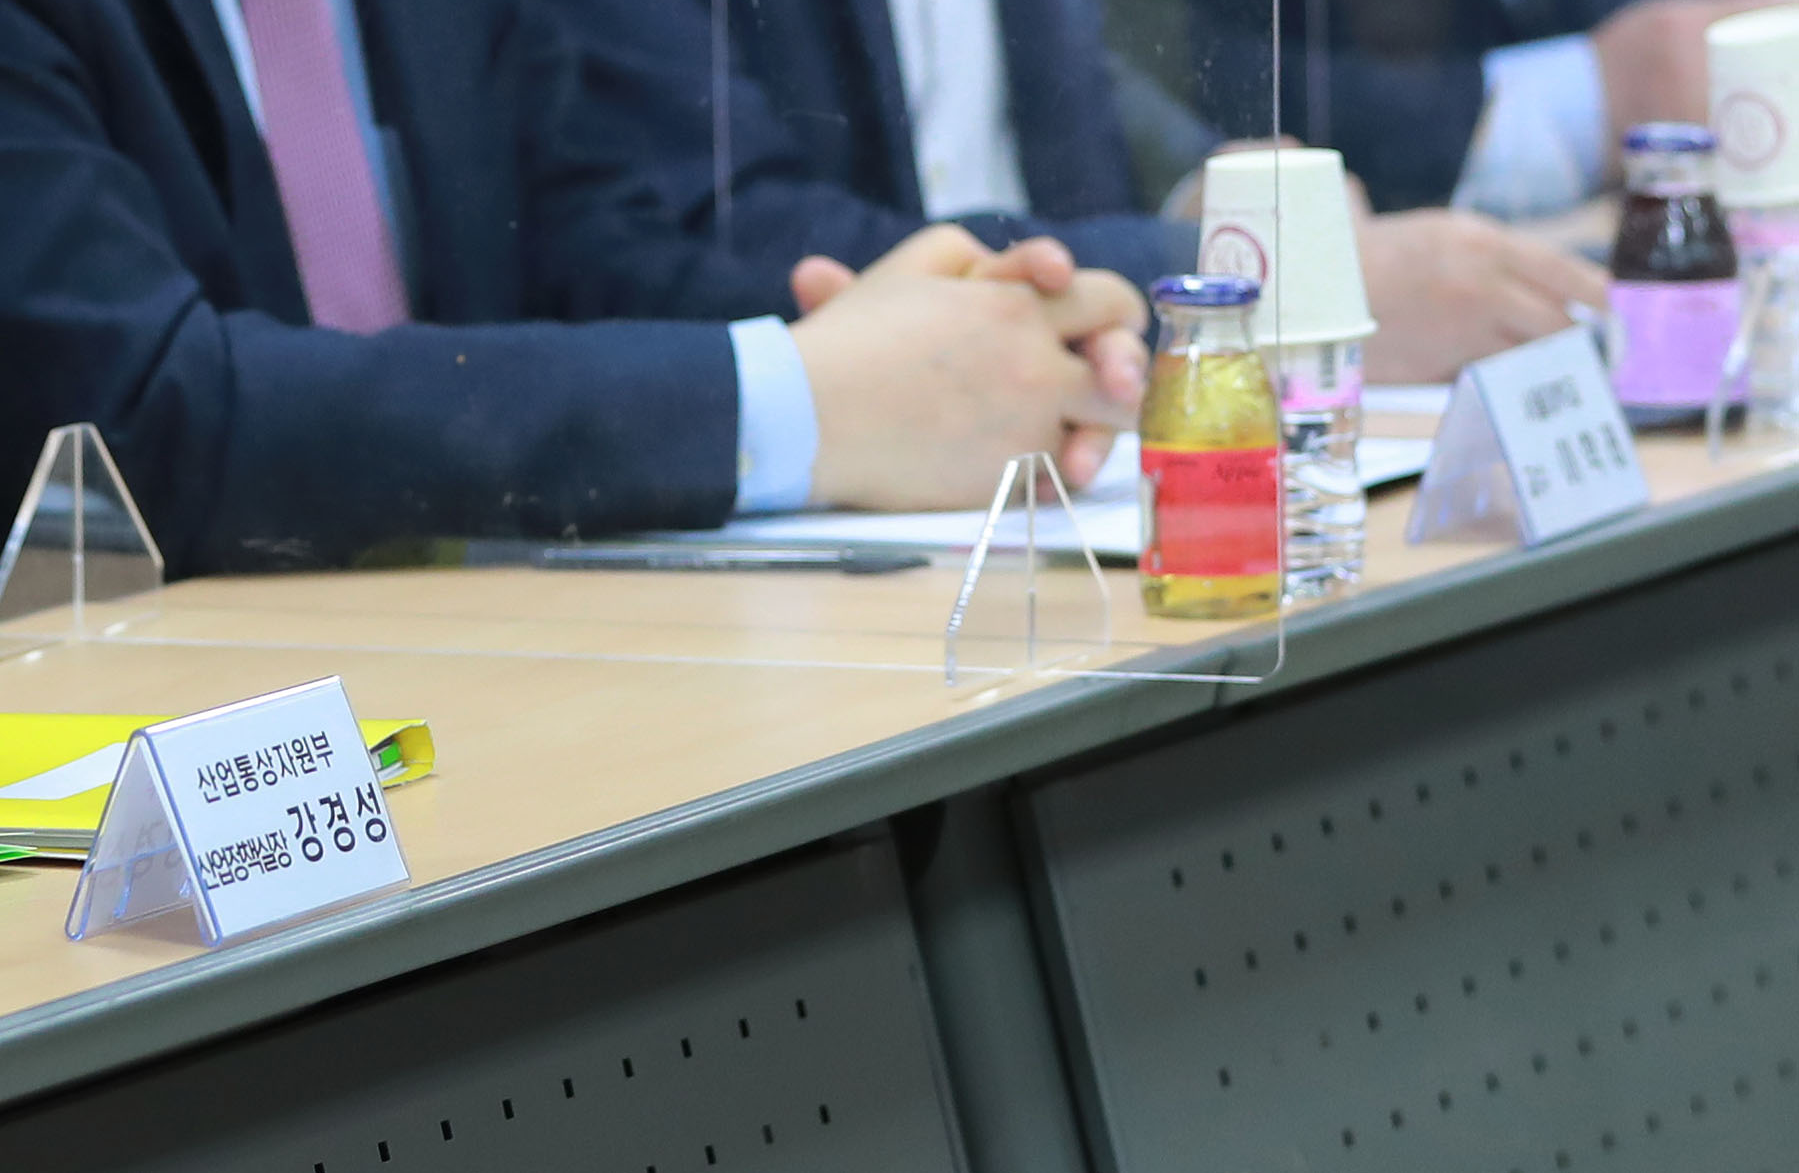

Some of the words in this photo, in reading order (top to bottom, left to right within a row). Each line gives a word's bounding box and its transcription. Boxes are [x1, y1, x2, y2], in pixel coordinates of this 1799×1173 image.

[197, 730, 334, 804] 산업통상자원부
[198, 829, 293, 891] 산업정책실장
[286, 781, 388, 863] 강경성
